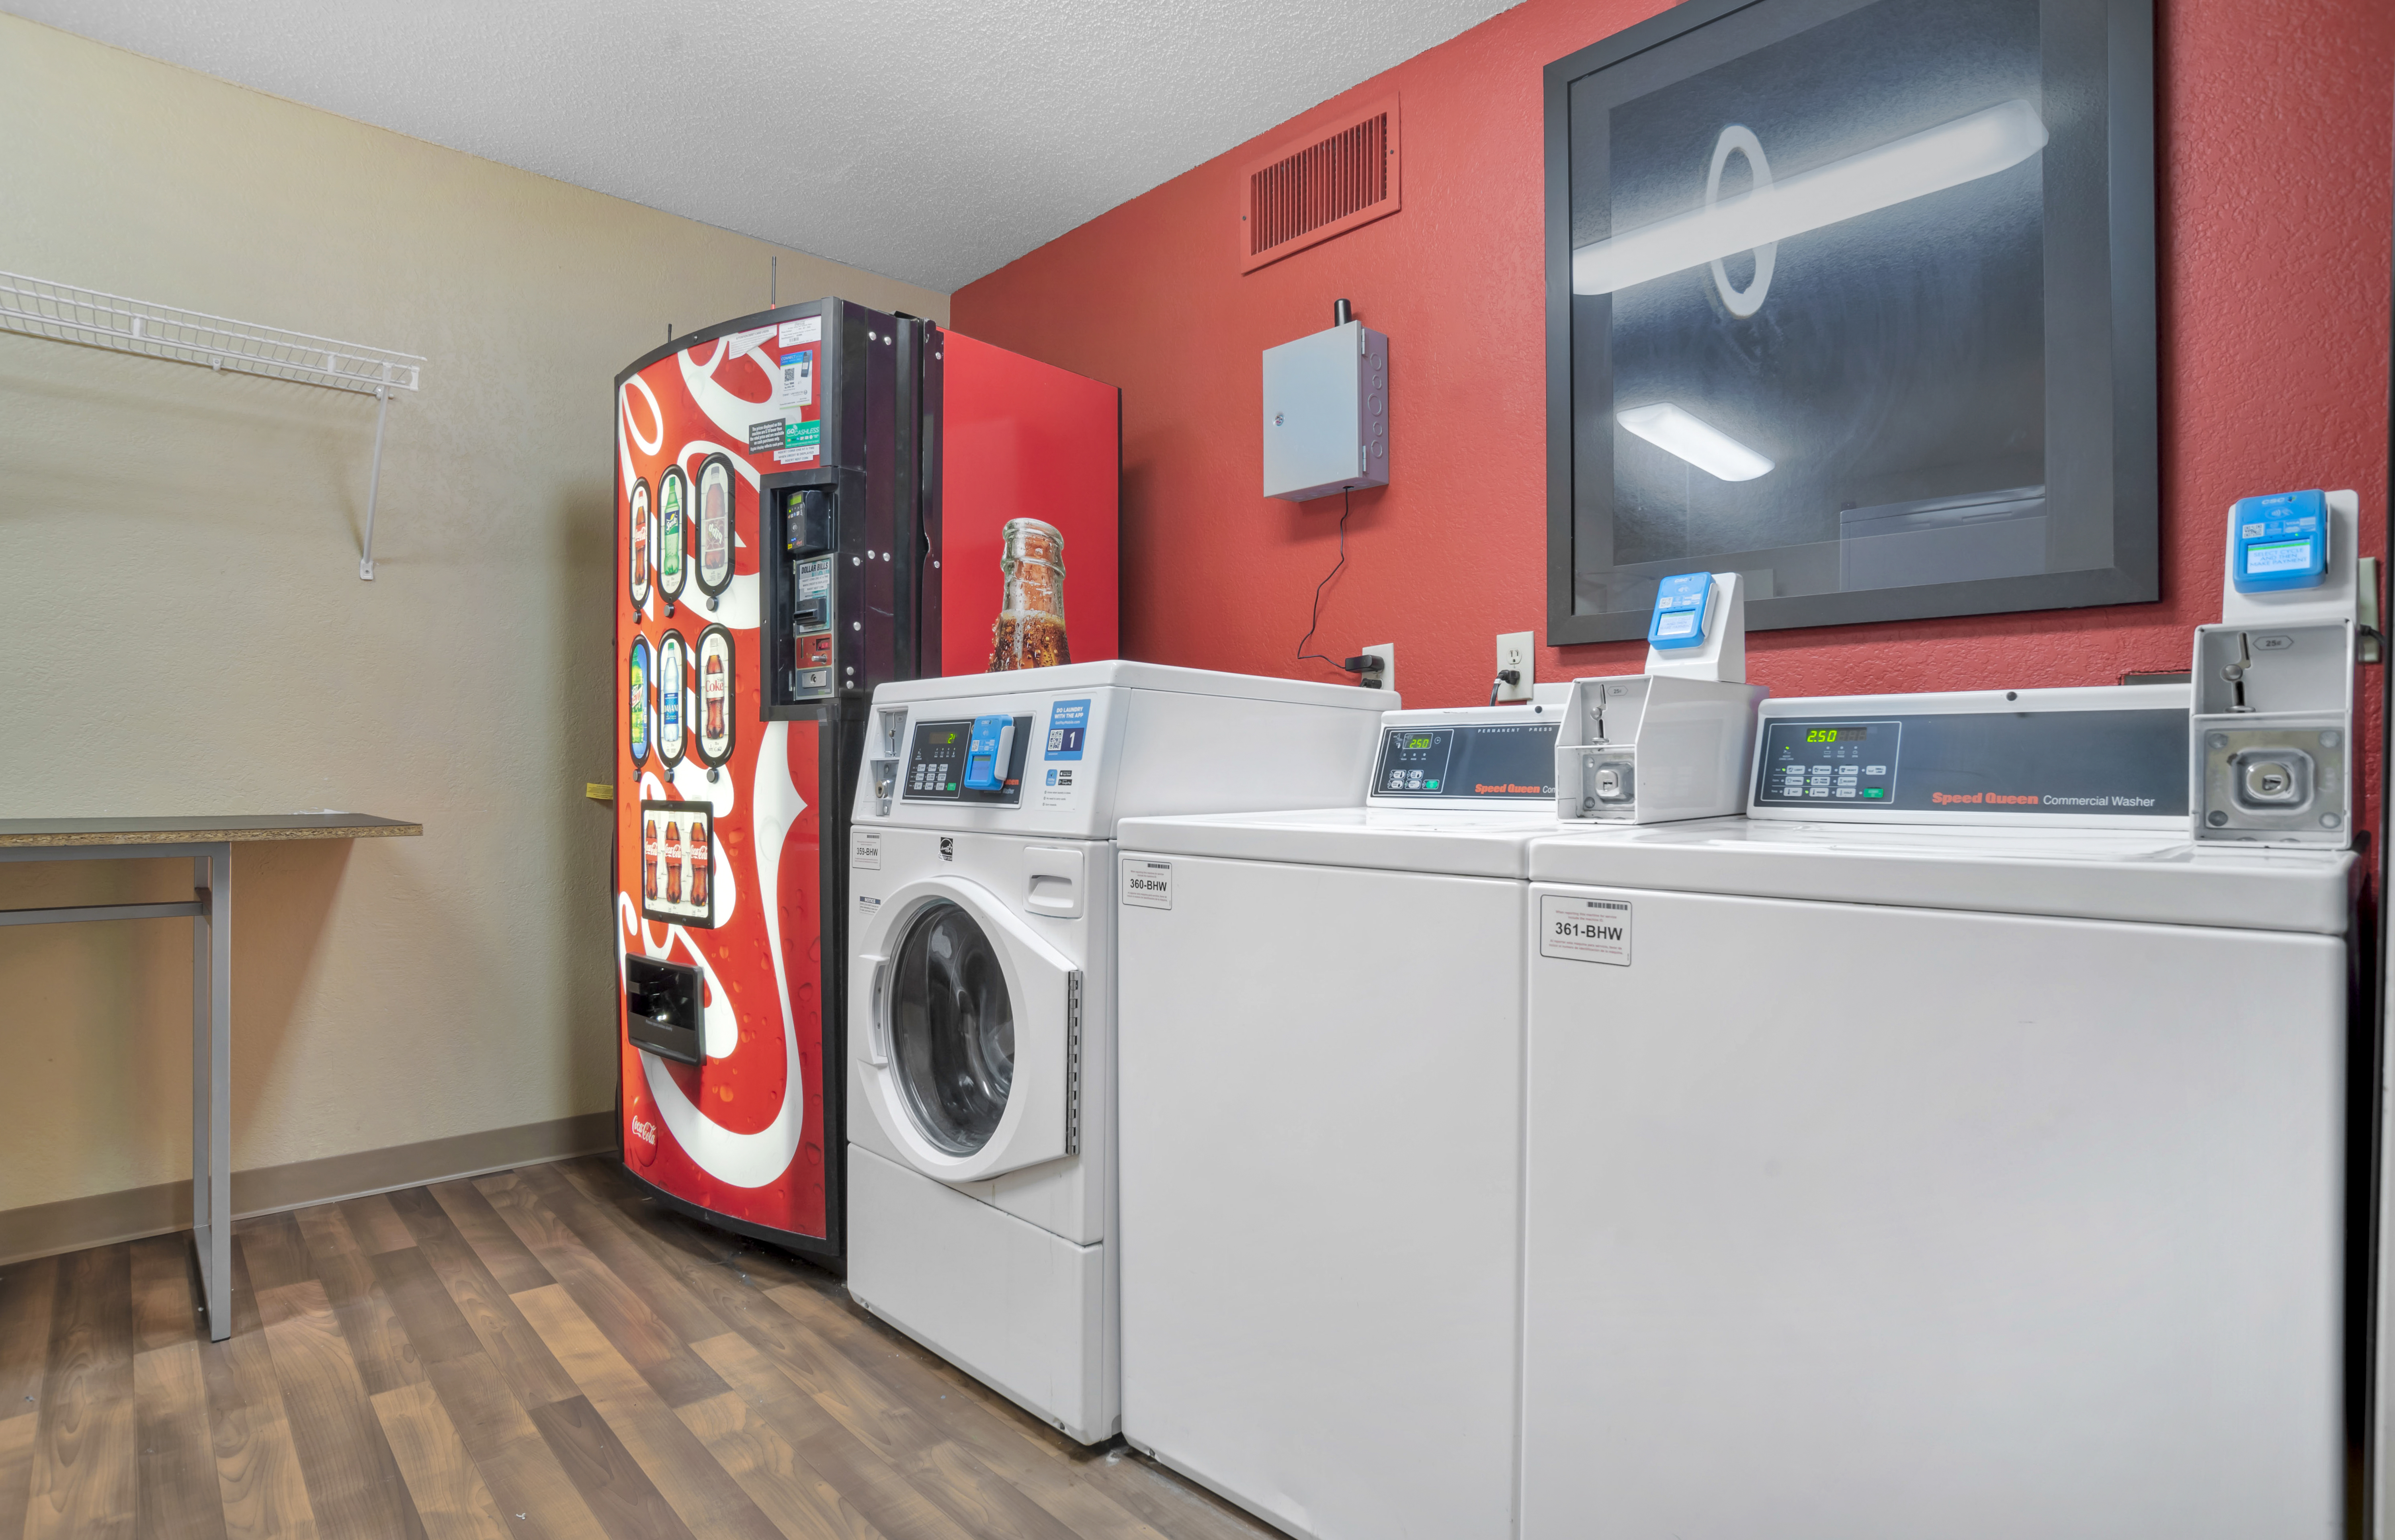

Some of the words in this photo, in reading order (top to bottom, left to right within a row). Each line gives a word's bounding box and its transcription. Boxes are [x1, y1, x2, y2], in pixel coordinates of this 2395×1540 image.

[794, 427, 819, 436] CASHLESS
[666, 516, 677, 531] Sprite
[802, 565, 816, 574] DOLLAR
[817, 562, 828, 571] BILLS
[706, 680, 723, 692] Coke
[664, 704, 678, 713] DASANI
[1070, 731, 1075, 748] 1
[1807, 730, 1837, 742] 2.50
[1410, 739, 1429, 748] 250
[1475, 784, 1507, 794] Speed
[1508, 784, 1540, 793] Queen
[1932, 792, 1983, 805] Speed
[1985, 792, 2038, 805] Queen
[2043, 795, 2108, 806] Commercial
[2112, 795, 2155, 807] Washer
[857, 848, 878, 856] 359-BHW
[1131, 879, 1167, 891] 360-BHW
[1555, 922, 1623, 941] 361-BHW
[632, 1115, 657, 1145] Coca-Cola
